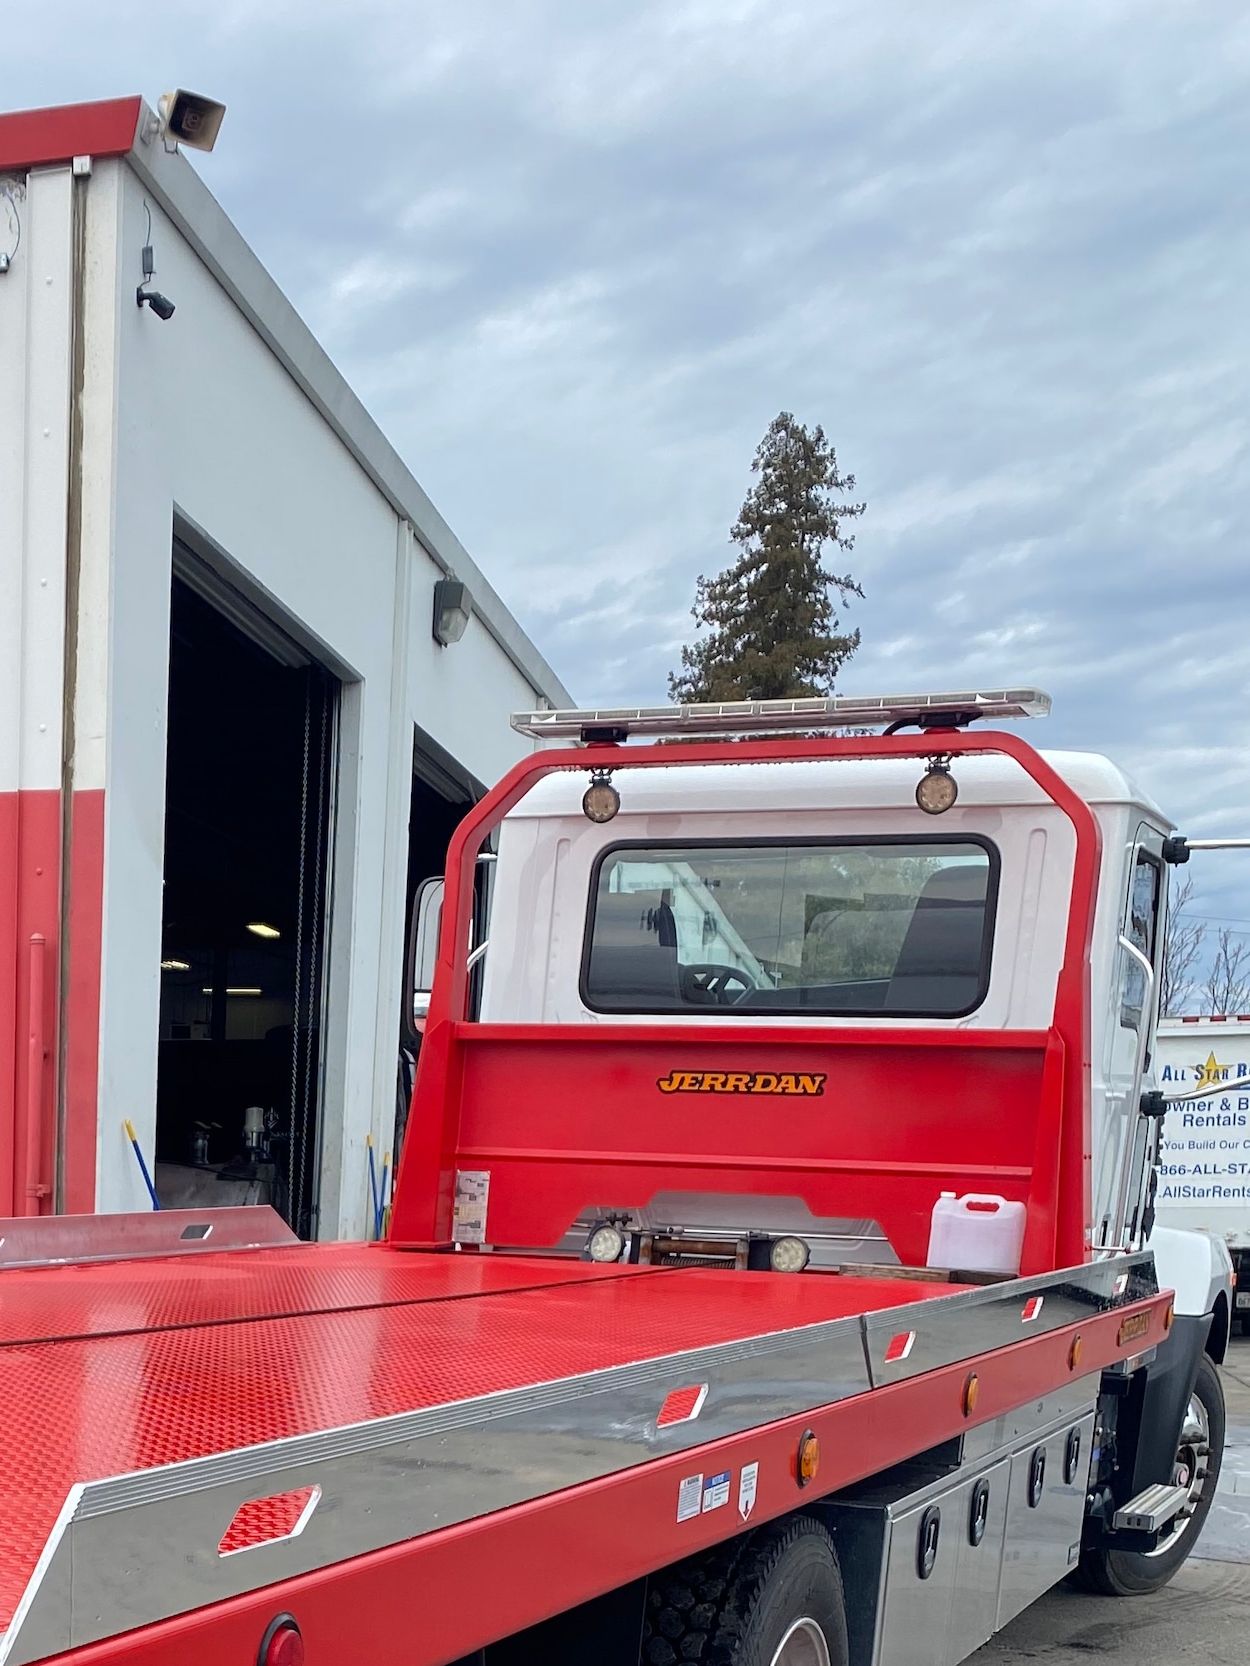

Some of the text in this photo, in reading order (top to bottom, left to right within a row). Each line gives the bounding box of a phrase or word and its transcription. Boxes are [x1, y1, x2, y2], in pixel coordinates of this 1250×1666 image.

[658, 1071, 826, 1094] JERR-DAN
[1219, 1097, 1231, 1111] &
[1182, 1112, 1247, 1127] Rentals
[1163, 1140, 1185, 1150] You
[1188, 1139, 1216, 1150] Build
[1219, 1139, 1240, 1150] Our
[1156, 1162, 1250, 1176] -866-ALL-ST
